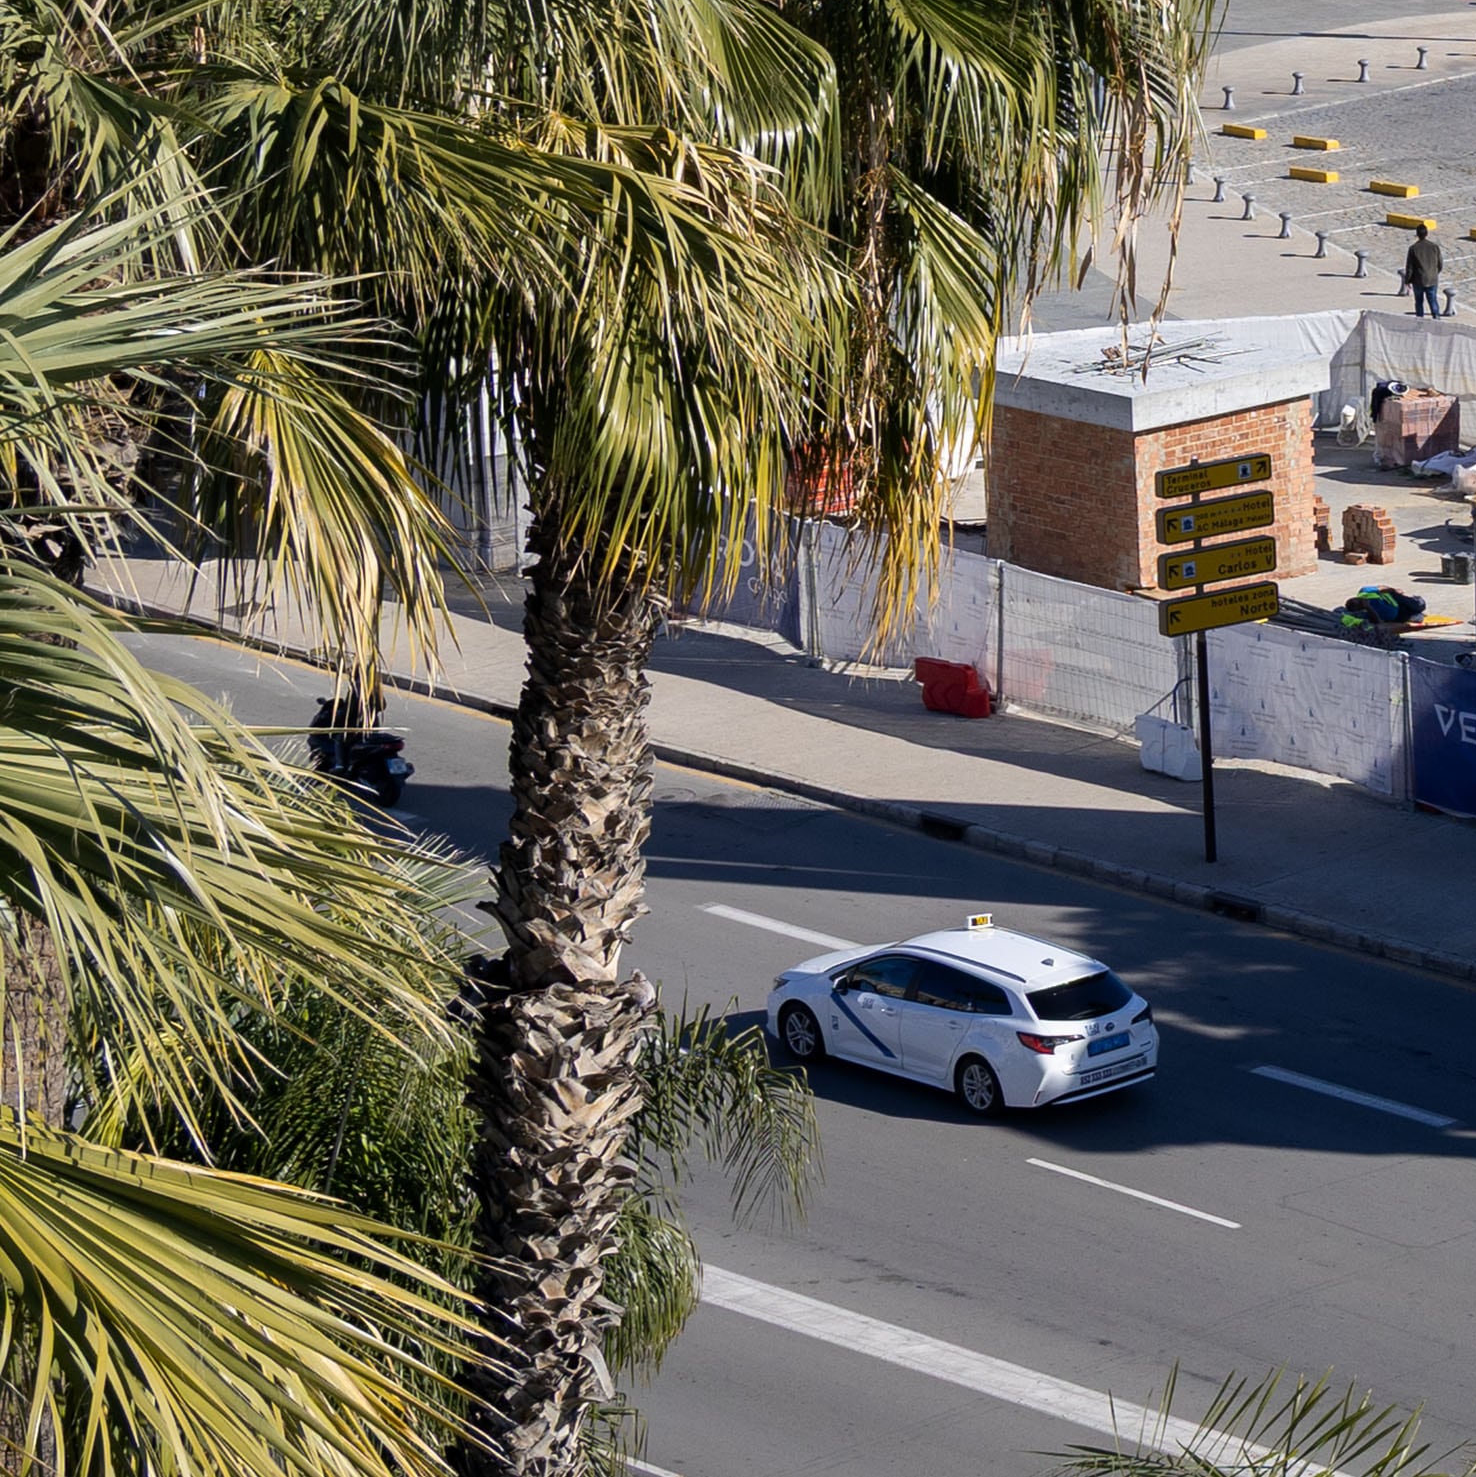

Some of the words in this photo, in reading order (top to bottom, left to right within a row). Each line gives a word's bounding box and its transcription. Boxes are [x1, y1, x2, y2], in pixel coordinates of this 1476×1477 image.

[1166, 469, 1208, 485] Terminal
[1166, 480, 1211, 494] Cruceros
[1243, 498, 1270, 512] Hotel
[1211, 517, 1244, 531] Málaga
[1245, 543, 1272, 556] Hotel
[1218, 560, 1257, 575] Carlos
[1265, 555, 1273, 565] V
[1211, 594, 1249, 608] hoteles
[1252, 588, 1274, 600] zona
[1240, 601, 1276, 617] Norte
